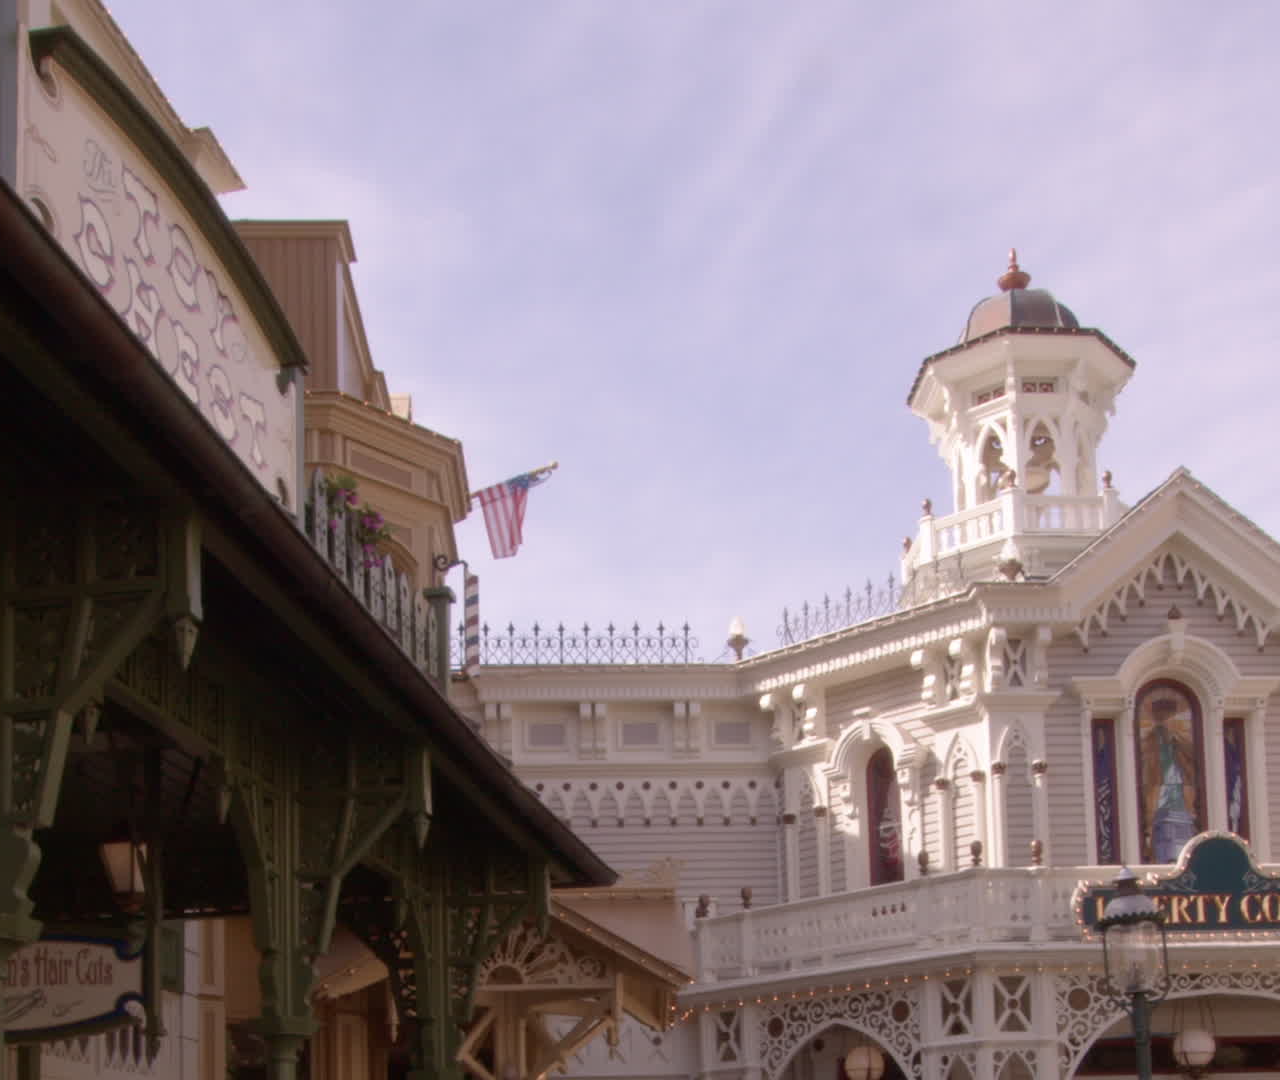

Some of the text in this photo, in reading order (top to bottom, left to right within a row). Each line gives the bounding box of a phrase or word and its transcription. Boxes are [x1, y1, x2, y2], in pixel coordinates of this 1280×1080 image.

[121, 159, 239, 357] TOY
[73, 191, 268, 470] CHEST
[34, 948, 73, 986] Hair
[76, 949, 114, 986] Cuts
[1095, 892, 1232, 924] LERTY
